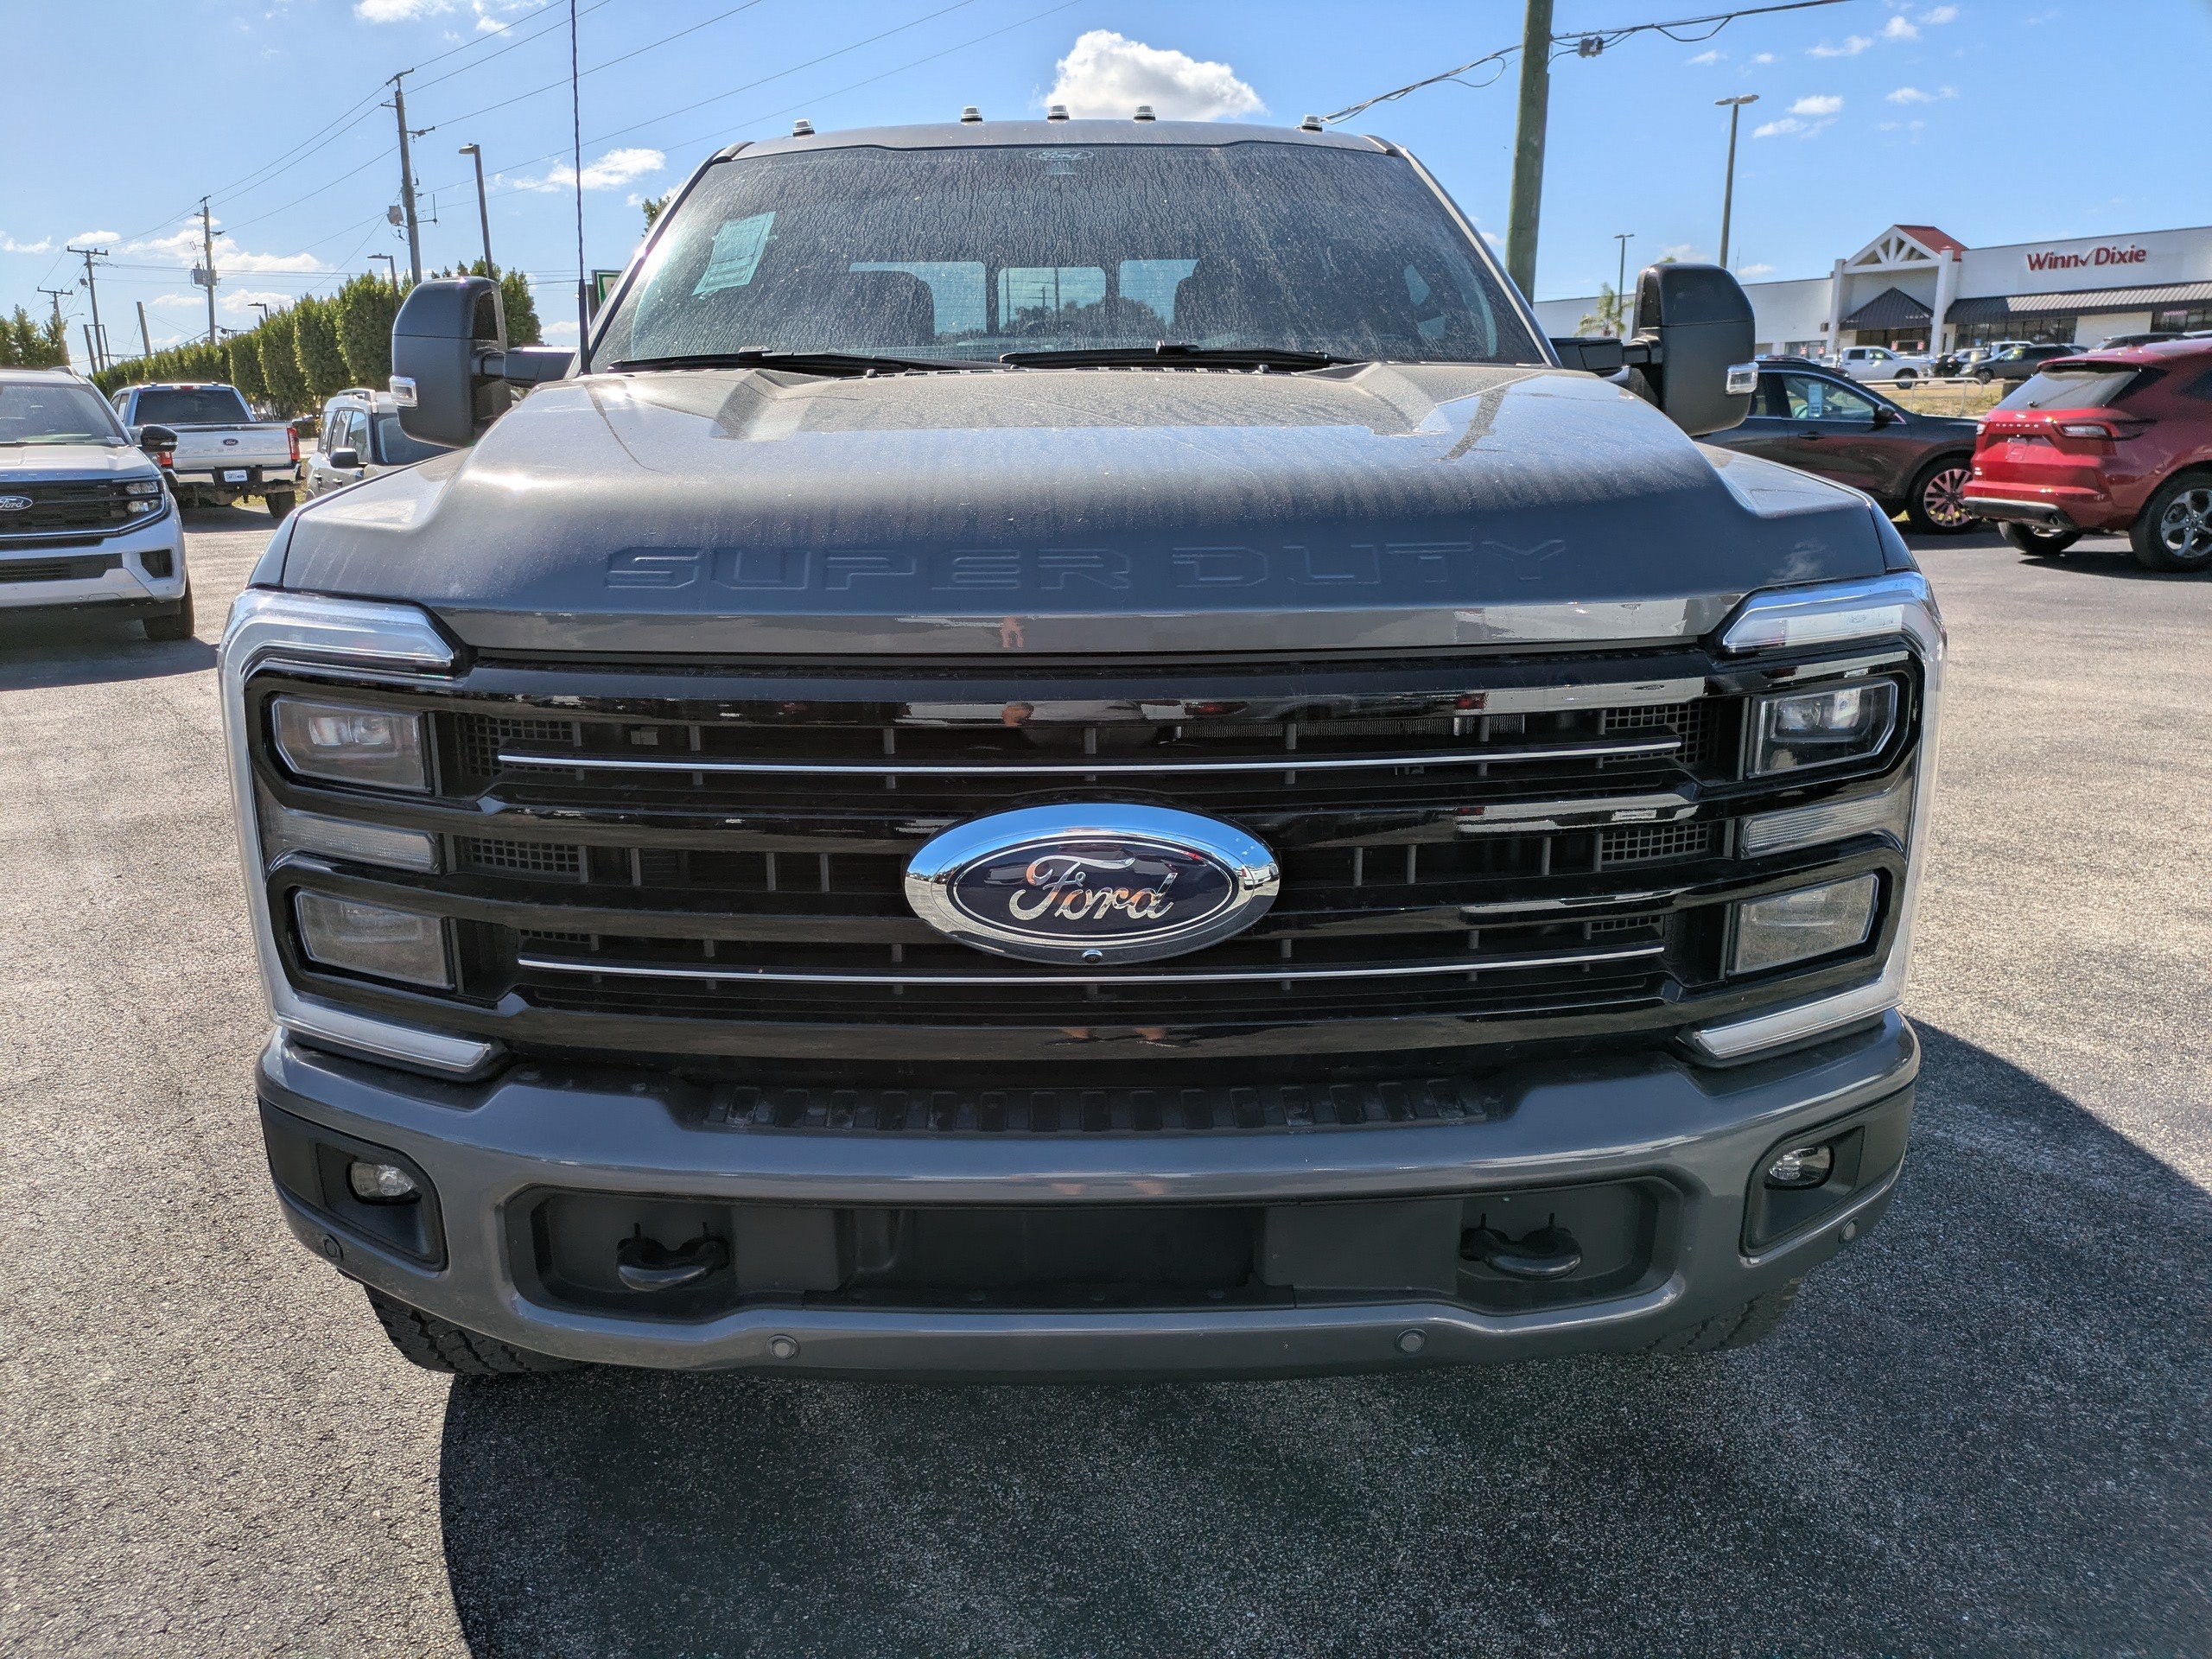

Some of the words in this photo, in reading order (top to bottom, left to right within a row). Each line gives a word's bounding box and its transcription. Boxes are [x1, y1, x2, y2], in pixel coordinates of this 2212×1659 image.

[605, 546, 1130, 591] SUPER
[1172, 538, 1567, 588] DUTY
[1008, 855, 1179, 920] Ford
